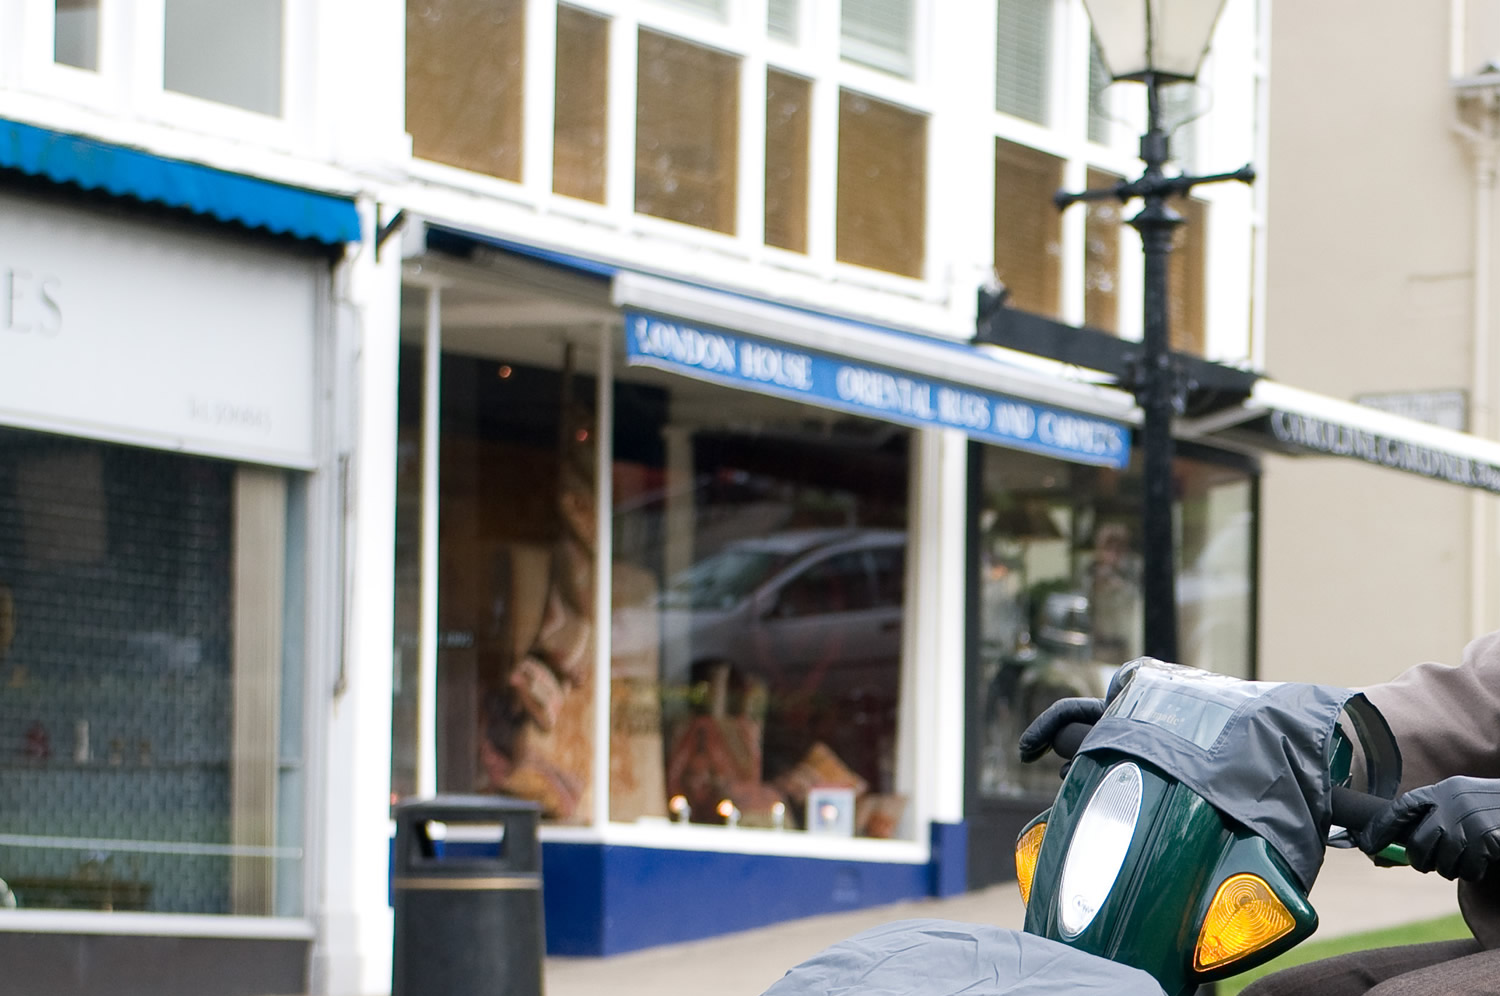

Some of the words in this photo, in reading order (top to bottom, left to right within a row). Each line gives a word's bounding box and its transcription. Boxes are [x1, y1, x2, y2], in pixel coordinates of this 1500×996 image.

[634, 317, 737, 375] LONDON
[739, 340, 814, 391] HOUSE
[836, 365, 936, 420] ORIENTAL
[937, 388, 991, 431] RUGS
[995, 402, 1036, 439] AND
[1037, 411, 1122, 455] CARPETS
